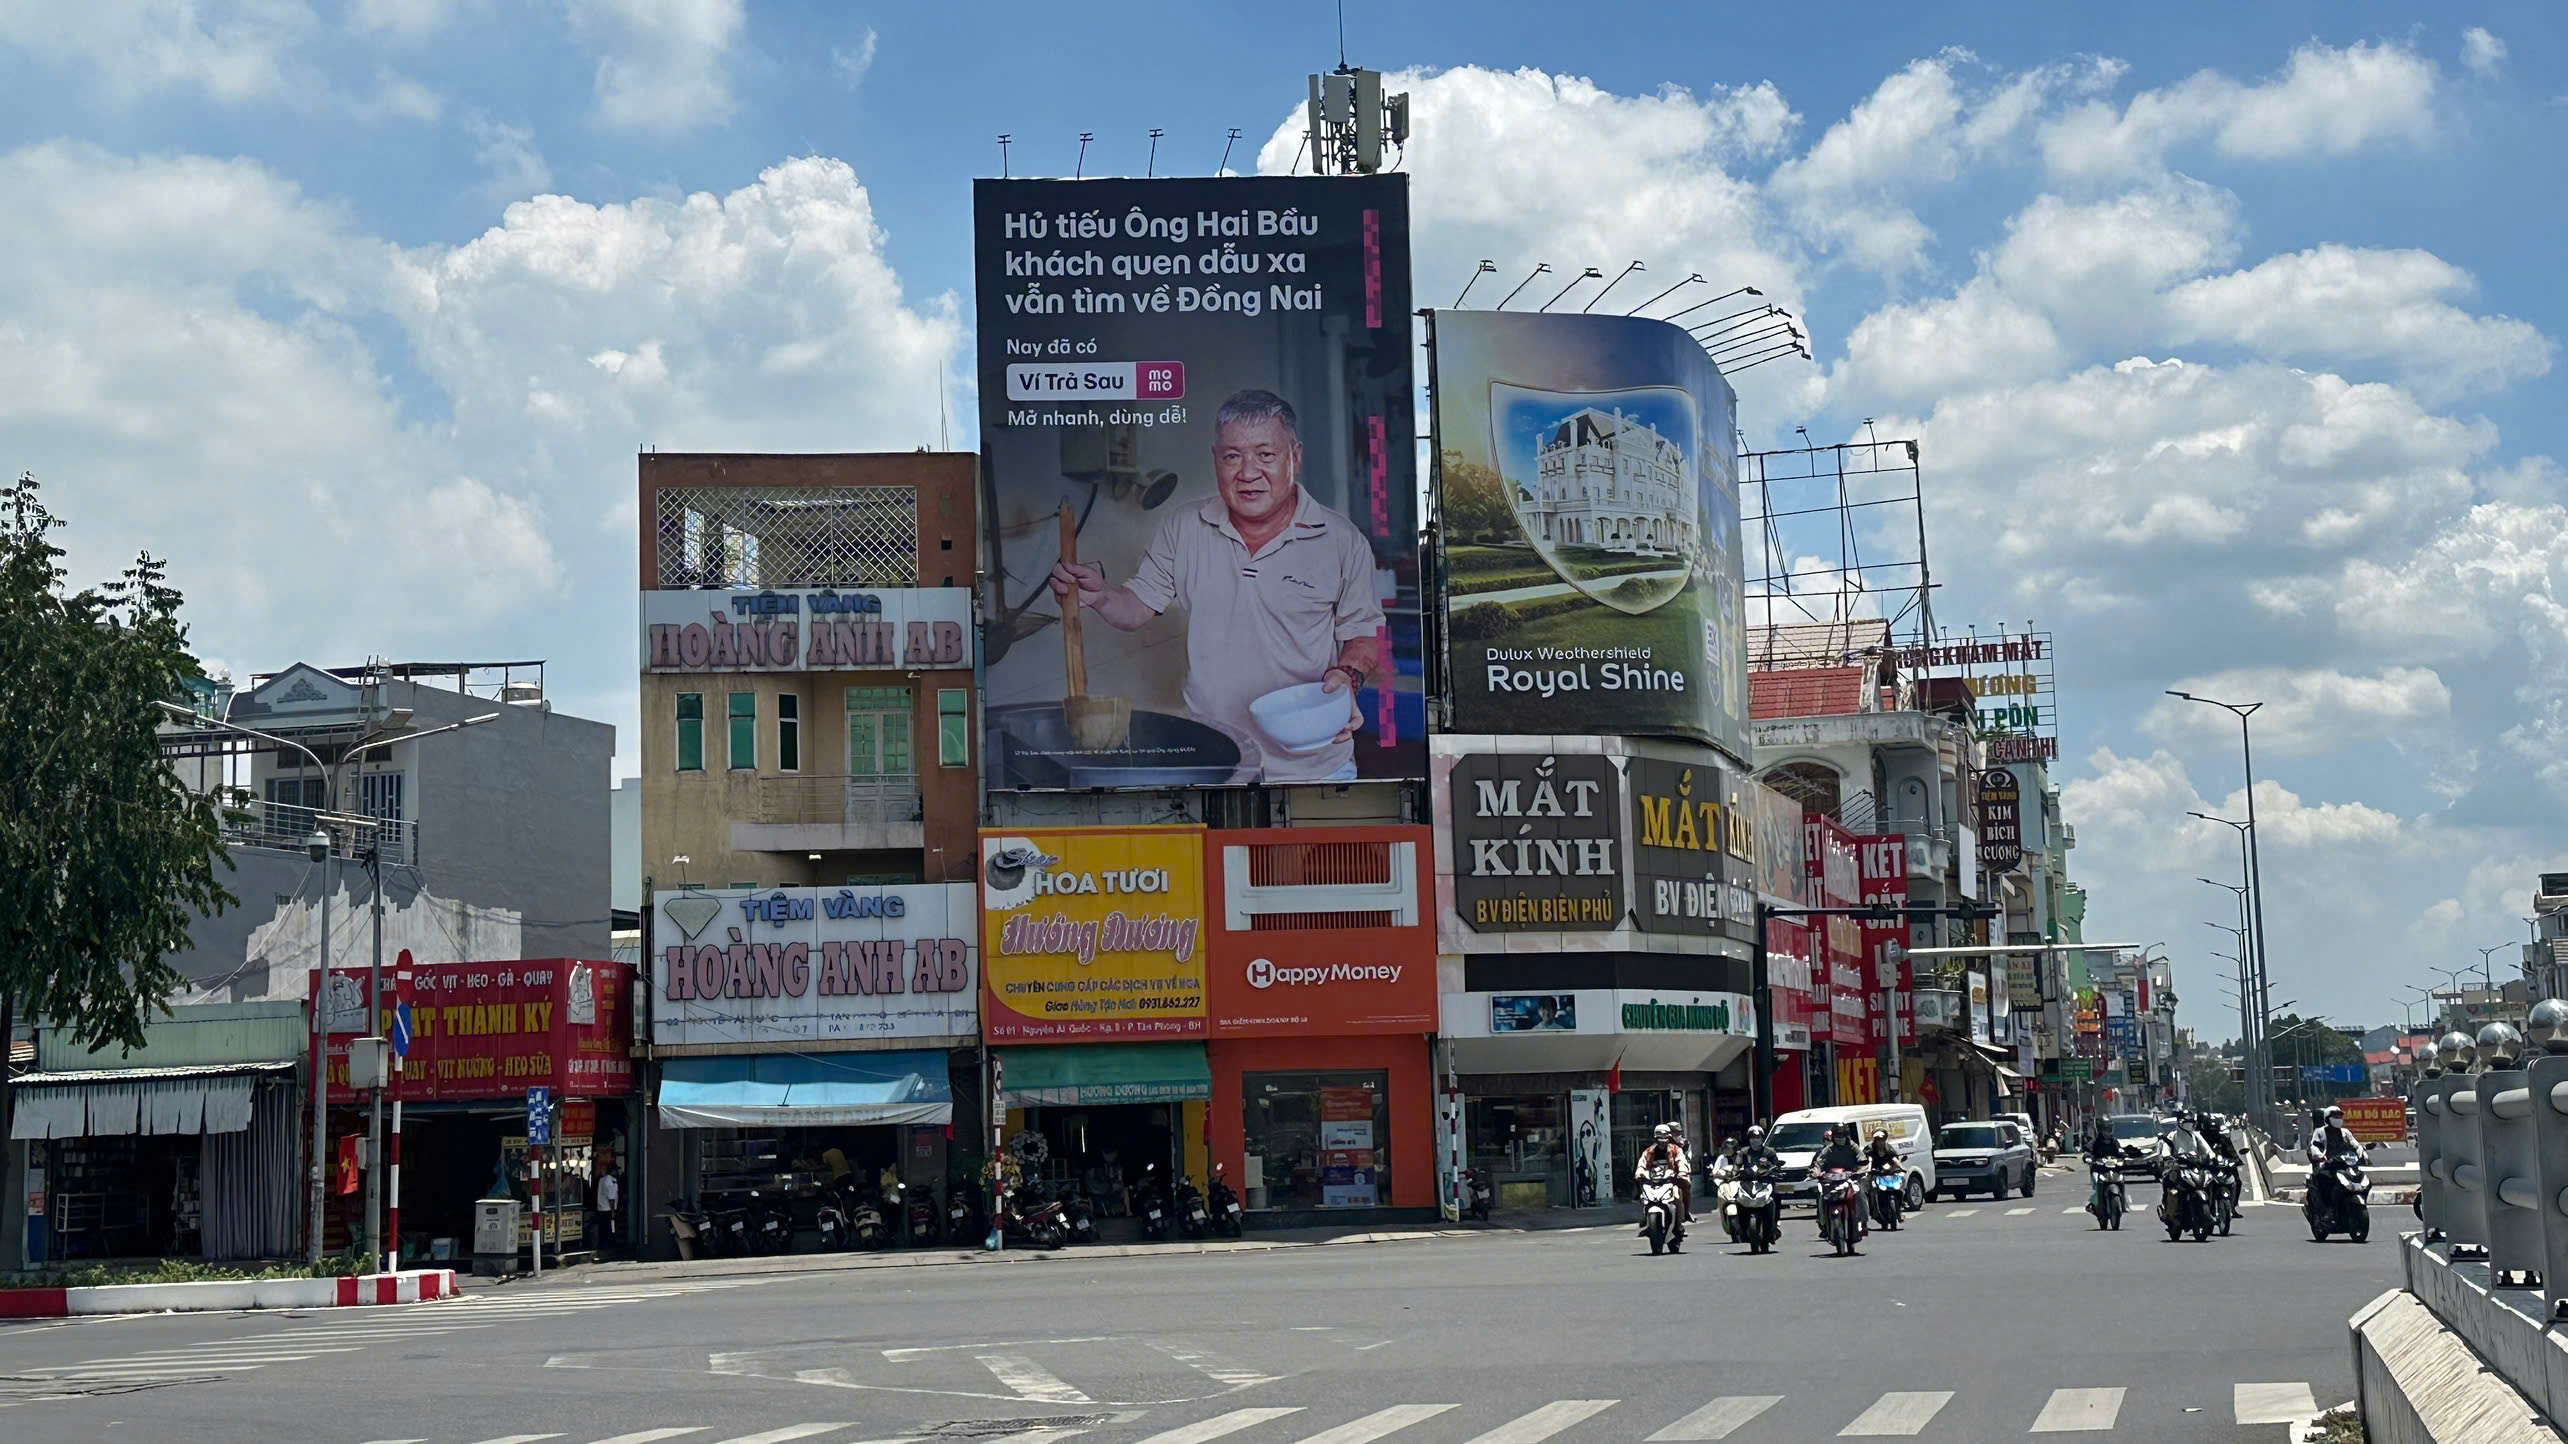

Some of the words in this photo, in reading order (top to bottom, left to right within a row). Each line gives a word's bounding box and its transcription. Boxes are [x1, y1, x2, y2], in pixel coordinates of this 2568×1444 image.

[1004, 209, 1049, 239] Hủ
[1055, 208, 1117, 239] tiếu
[1125, 205, 1189, 242] Ông
[1197, 210, 1250, 238] Hai
[1257, 207, 1319, 237] Bầu
[1004, 249, 1104, 277] khách
[1111, 253, 1192, 284] quen
[1198, 243, 1260, 274] dẫu
[1267, 252, 1306, 273] xa
[1004, 283, 1065, 314] vẫn
[1073, 286, 1125, 314] tìm
[1132, 284, 1170, 313] về
[1176, 284, 1262, 317] Đồng
[1270, 284, 1322, 311] Nai
[1006, 339, 1043, 357] Nay
[1047, 339, 1071, 356] đã
[1075, 338, 1098, 355] có
[1019, 372, 1042, 391] Ví
[1045, 371, 1079, 391] Trả
[1083, 371, 1125, 390] Sau
[1008, 409, 1038, 427] Mở
[1042, 410, 1105, 428] nhanh,
[1109, 409, 1154, 428] dùng
[1158, 405, 1187, 425] dễ!
[649, 610, 798, 668] HOÀNG
[807, 621, 895, 666] ANH
[903, 620, 964, 665] AB
[1487, 648, 1533, 661] Dulux
[1537, 647, 1651, 661] Weathershield
[1487, 663, 1591, 698] Royal
[1600, 662, 1685, 691] Shine
[1475, 757, 1600, 817] MẮT
[1640, 768, 1721, 851] MẮT
[1988, 805, 2012, 820] KIM
[1469, 824, 1615, 876] KÍNH
[1862, 837, 1903, 878] KÉT
[1034, 871, 1098, 896] HOA
[1102, 867, 1169, 894] TƯƠI
[1654, 879, 1680, 916] BV
[1684, 873, 1729, 928] ĐIỆN
[740, 892, 814, 928] TIỆM
[822, 889, 905, 919] VÀNG
[1476, 899, 1499, 923] BV
[1502, 891, 1539, 928] ĐIỆN
[1542, 892, 1579, 922] BIÊN
[1582, 889, 1613, 921] PHỦ
[442, 975, 458, 993] VỊT
[467, 974, 489, 988] HEO
[498, 968, 514, 986] GÀ
[523, 970, 553, 988] QUAY
[666, 927, 810, 1001] HOÀNG
[819, 939, 905, 995] ANH
[912, 938, 969, 994] AB
[381, 1001, 436, 1037] PÁT
[443, 998, 517, 1036] THÀNH
[524, 995, 553, 1033] KÝ
[504, 1056, 528, 1077] HEO
